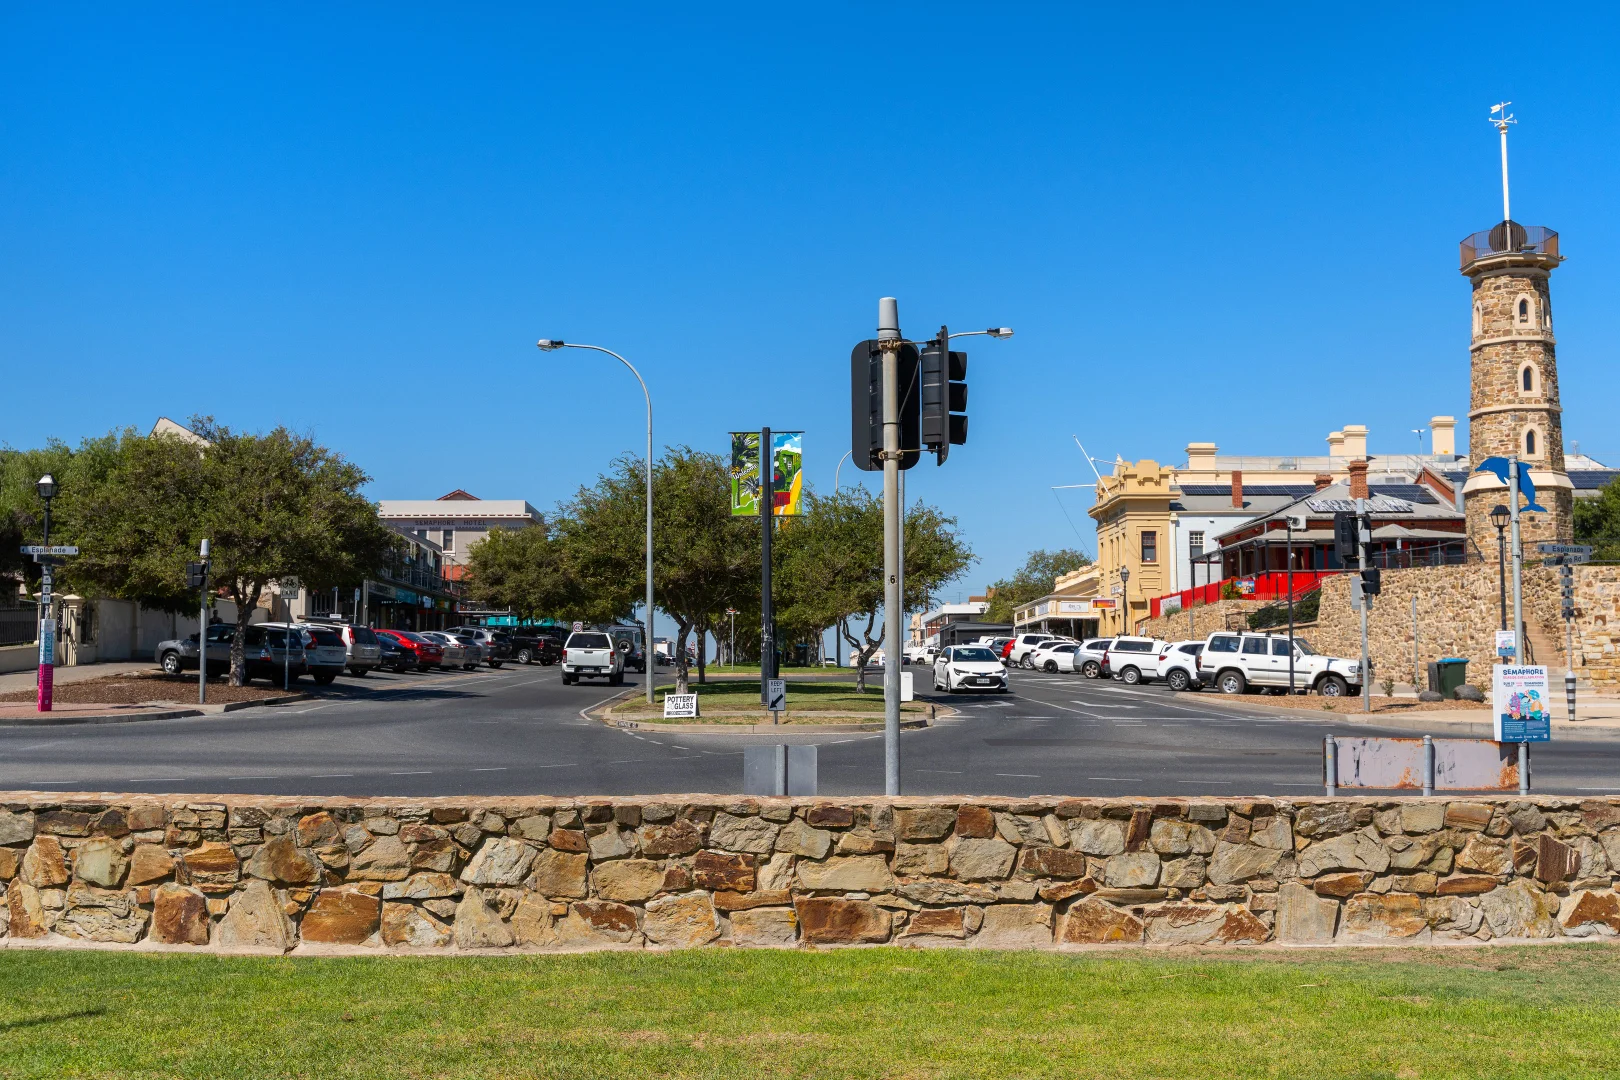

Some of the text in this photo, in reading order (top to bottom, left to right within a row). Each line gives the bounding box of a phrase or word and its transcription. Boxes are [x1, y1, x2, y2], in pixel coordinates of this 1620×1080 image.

[31, 546, 67, 554] Esplanade
[1552, 545, 1584, 554] Esplanade
[1573, 555, 1582, 563] Rd
[890, 575, 895, 584] 6
[1503, 668, 1544, 676] SEMAPHORE
[667, 695, 695, 703] POTTERY
[674, 702, 694, 710] GLASS
